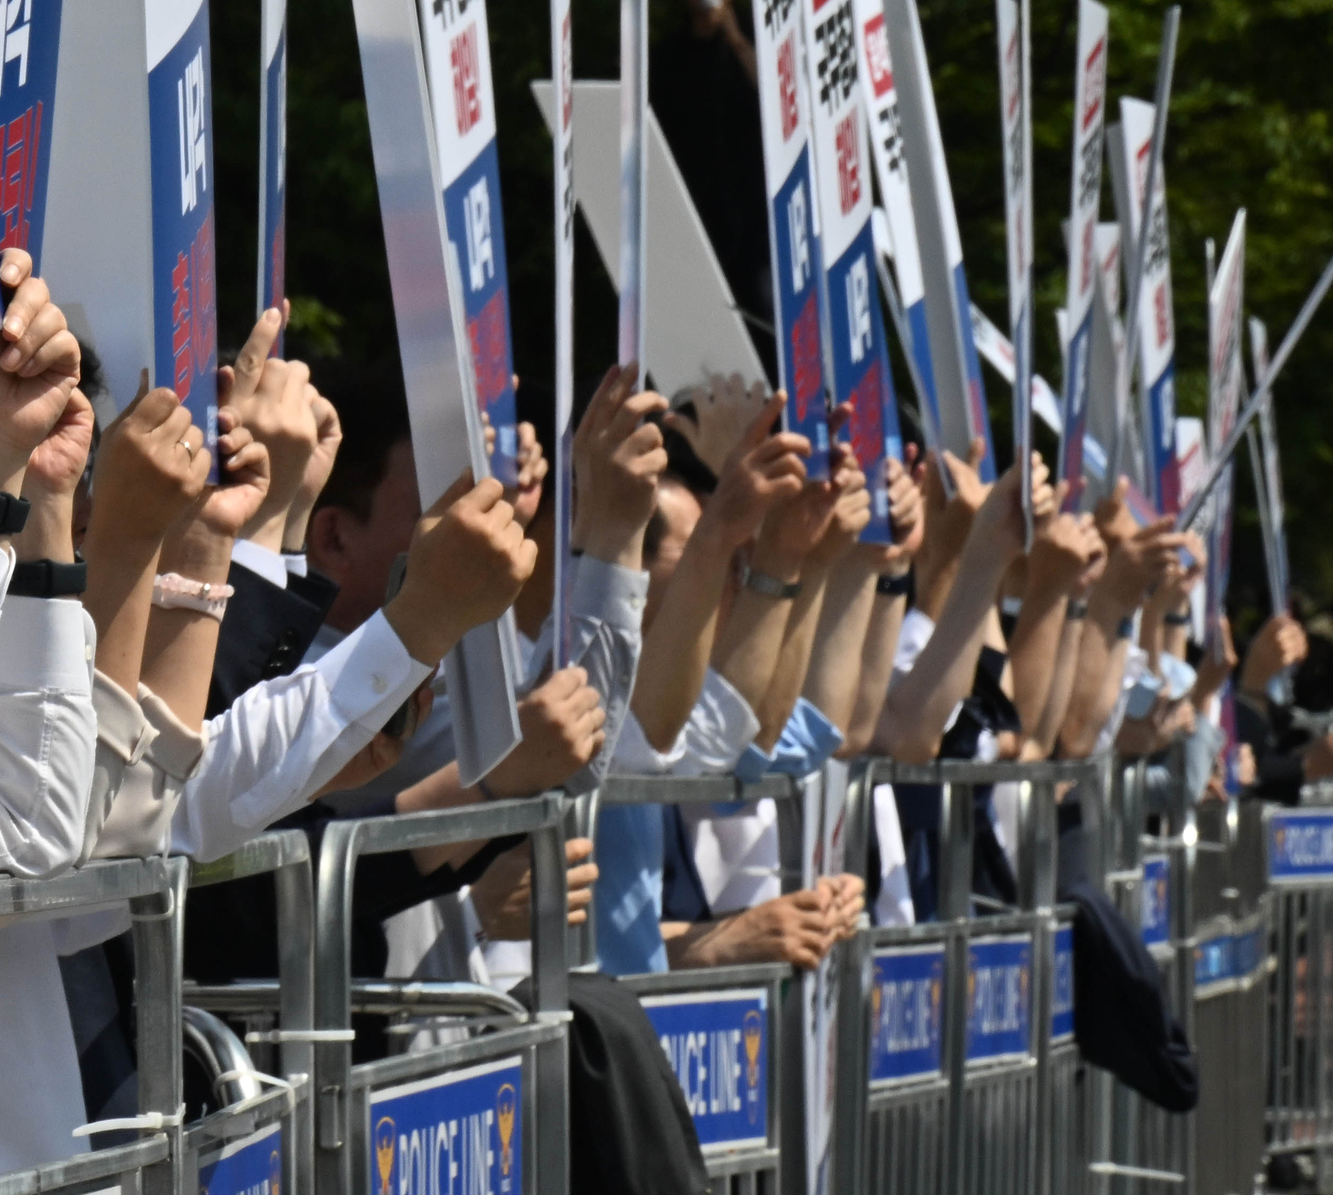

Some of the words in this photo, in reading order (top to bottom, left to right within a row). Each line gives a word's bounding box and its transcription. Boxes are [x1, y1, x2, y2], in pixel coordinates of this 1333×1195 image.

[177, 45, 207, 217] 내각
[710, 1028, 741, 1115] LINE
[398, 1119, 458, 1195] POLICE
[461, 1109, 494, 1195] LINE
